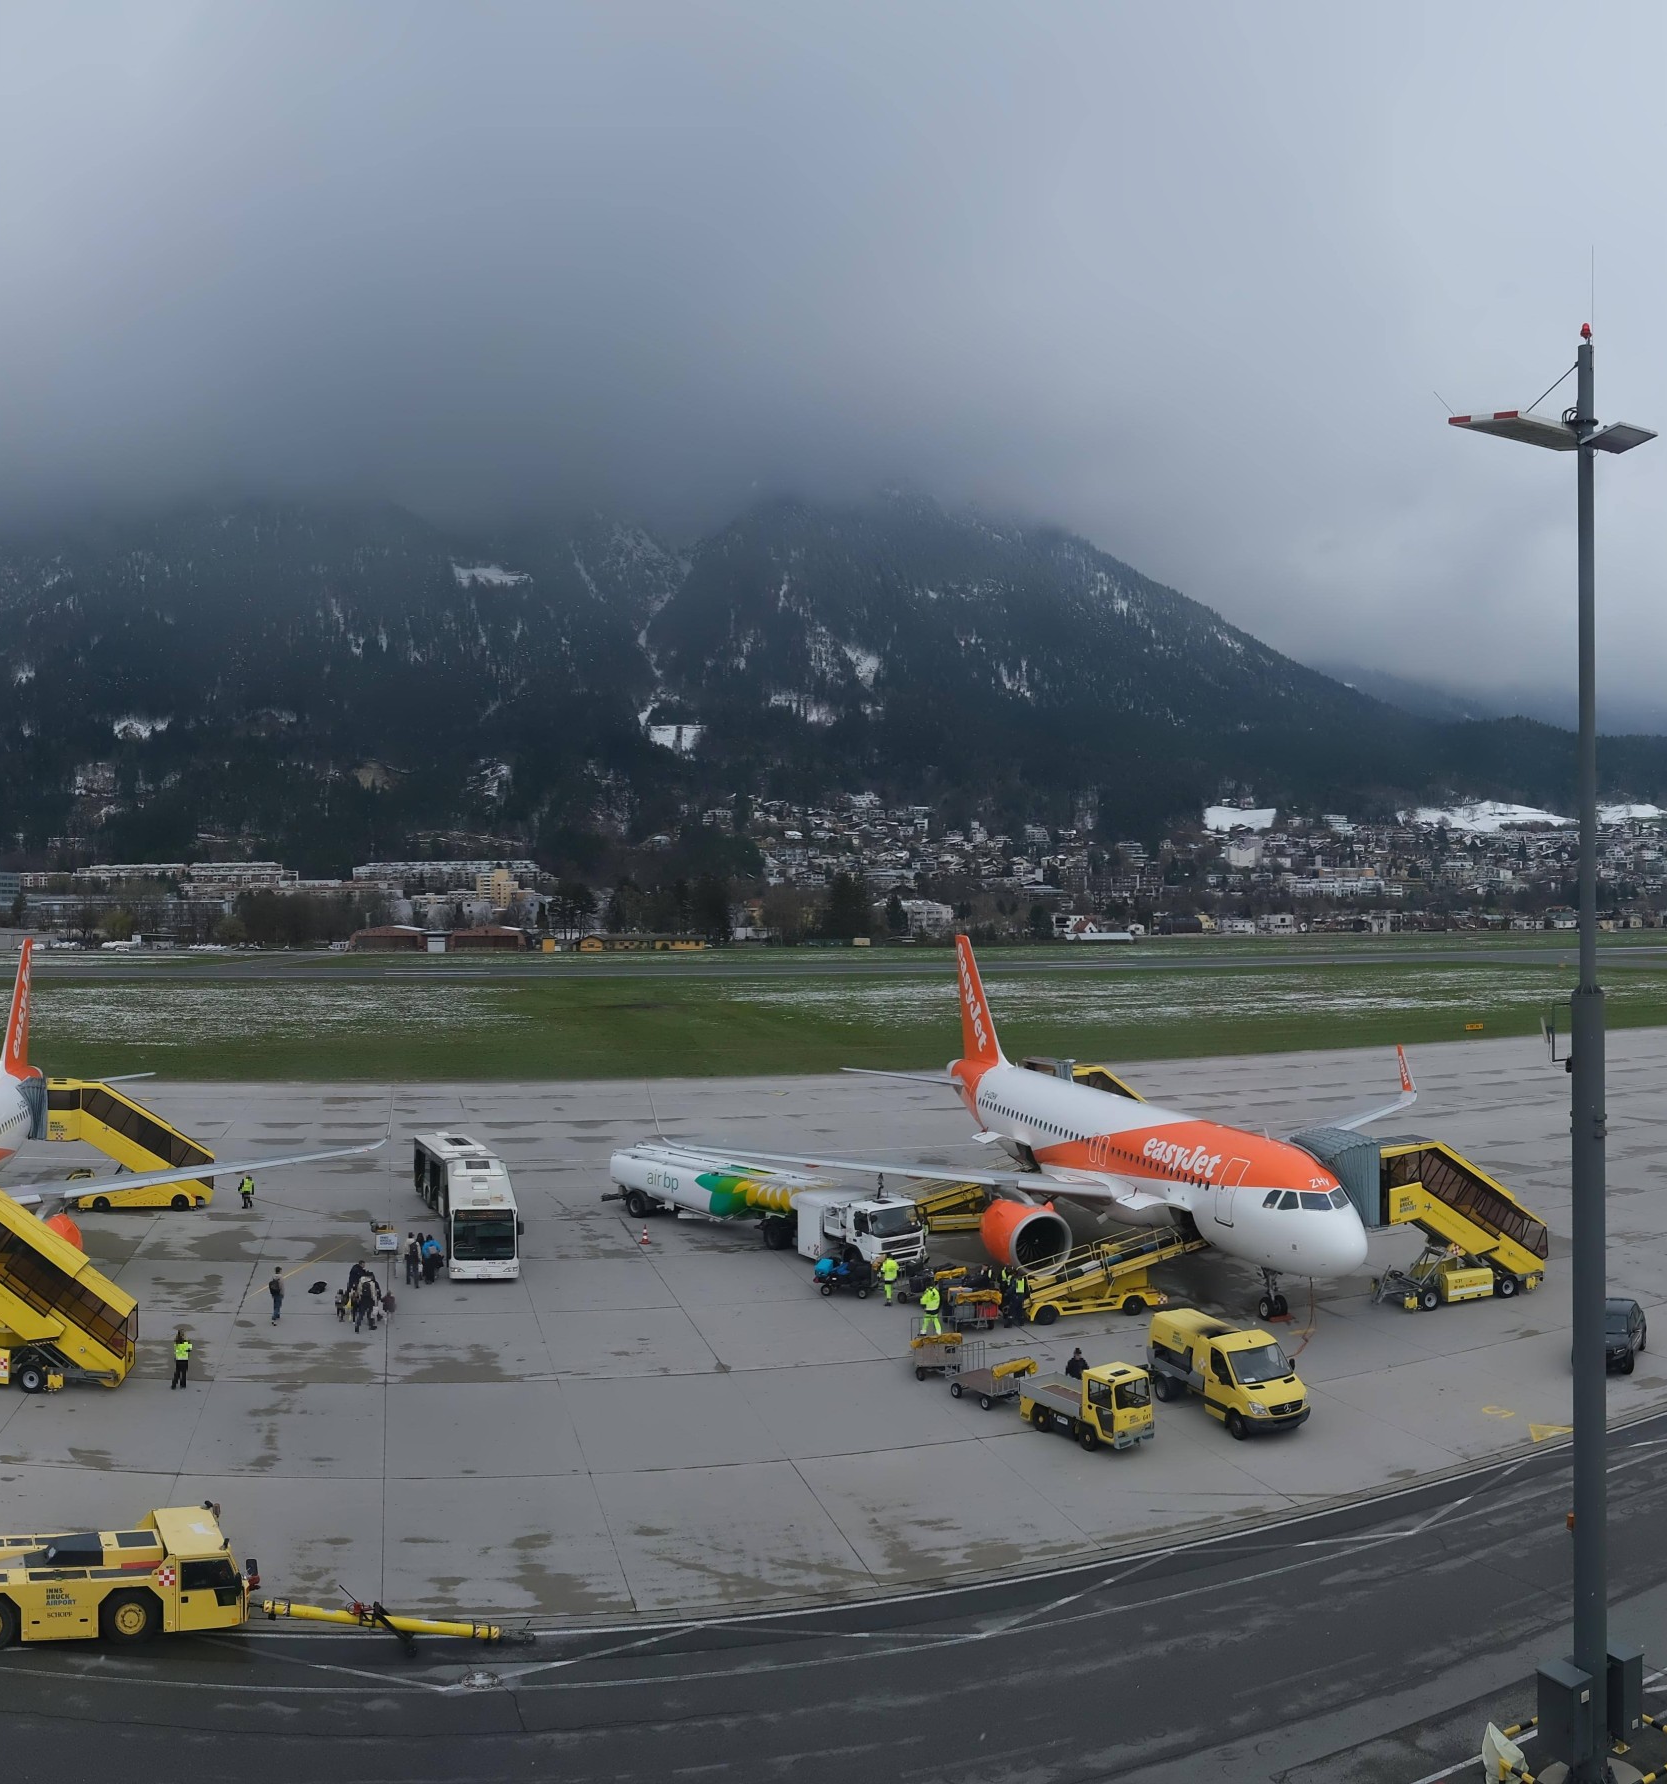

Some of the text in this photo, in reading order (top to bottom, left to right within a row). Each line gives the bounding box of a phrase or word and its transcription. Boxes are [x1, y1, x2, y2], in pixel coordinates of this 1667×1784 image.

[958, 943, 987, 1052] easyJet
[1143, 1138, 1222, 1178] easyJet
[647, 1169, 679, 1193] air bp
